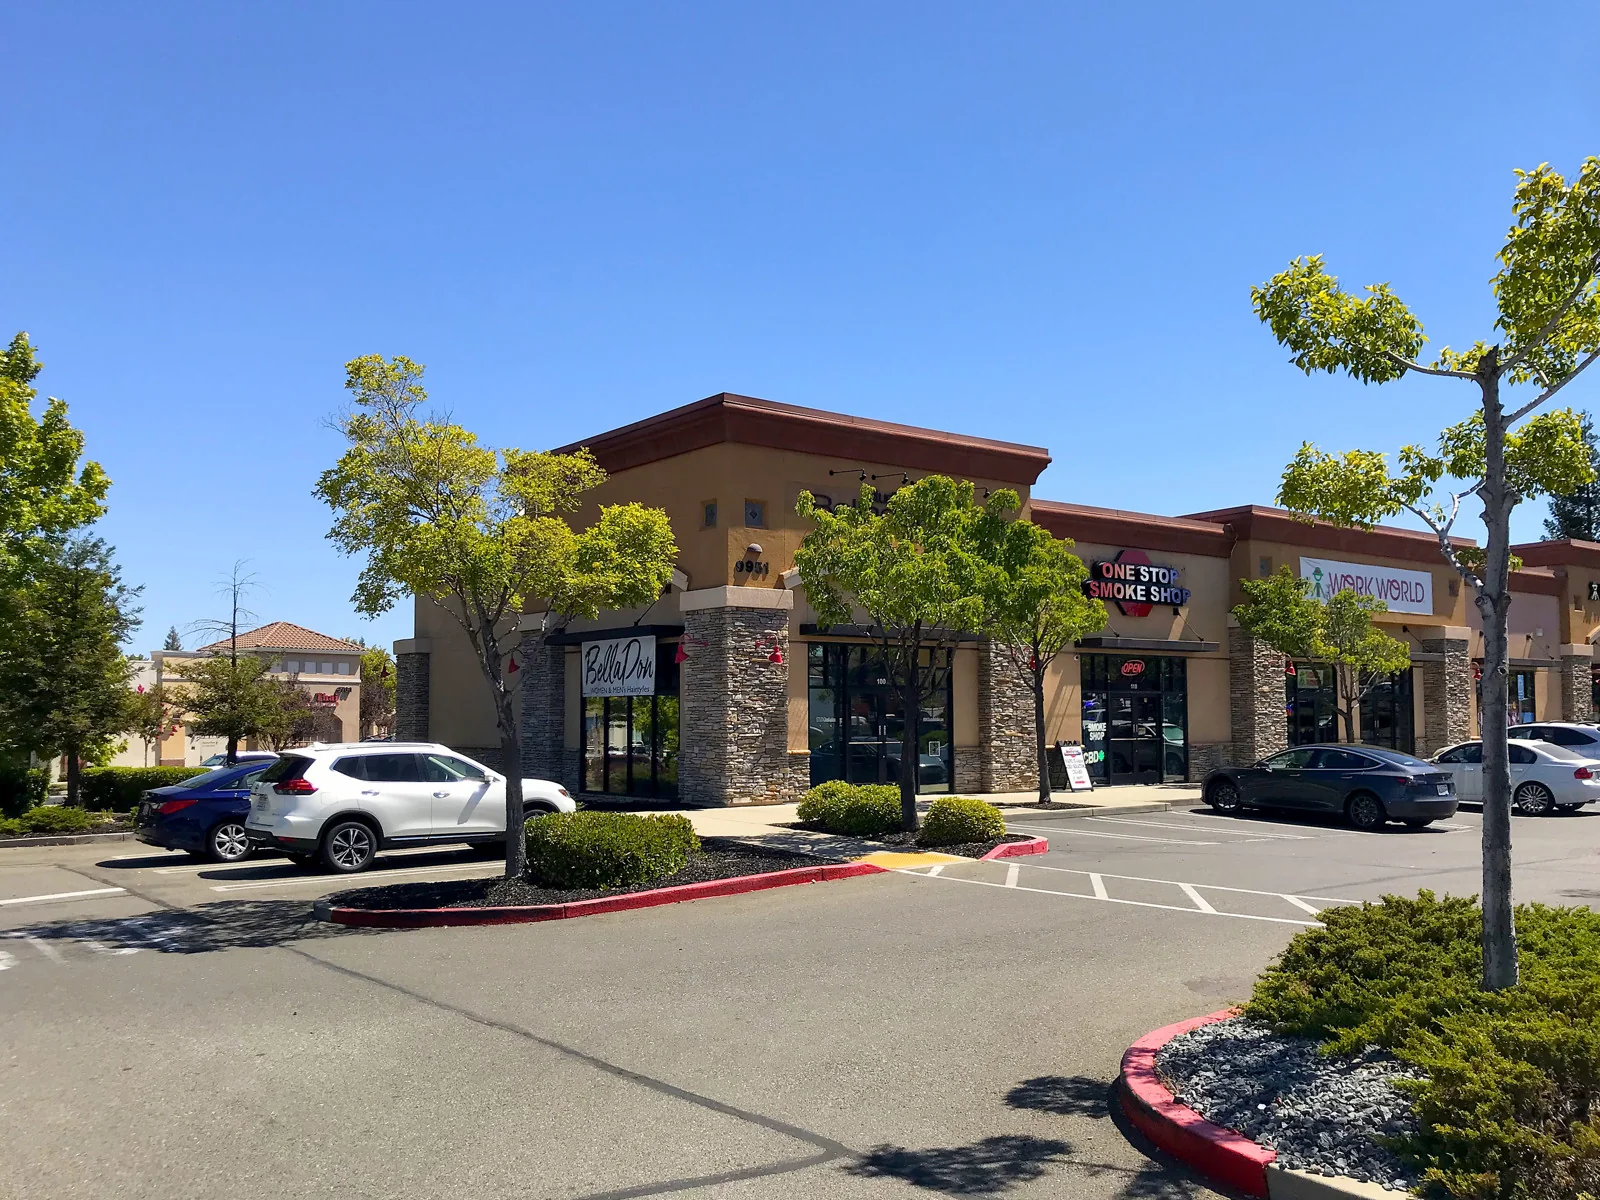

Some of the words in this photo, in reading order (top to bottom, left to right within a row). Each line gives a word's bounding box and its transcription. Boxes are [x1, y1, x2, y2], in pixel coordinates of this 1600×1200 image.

[735, 560, 769, 574] 9951
[1102, 562, 1136, 580] ONE
[1140, 566, 1179, 584] STOP
[1089, 580, 1147, 601] SMOKE
[1150, 586, 1192, 603] SHOP
[1328, 572, 1374, 598] WORK
[1376, 577, 1425, 603] WORLD
[1122, 662, 1143, 673] OPEN
[1087, 722, 1107, 732] SMOKE
[1089, 731, 1105, 741] SHOP
[1083, 750, 1099, 765] CBD
